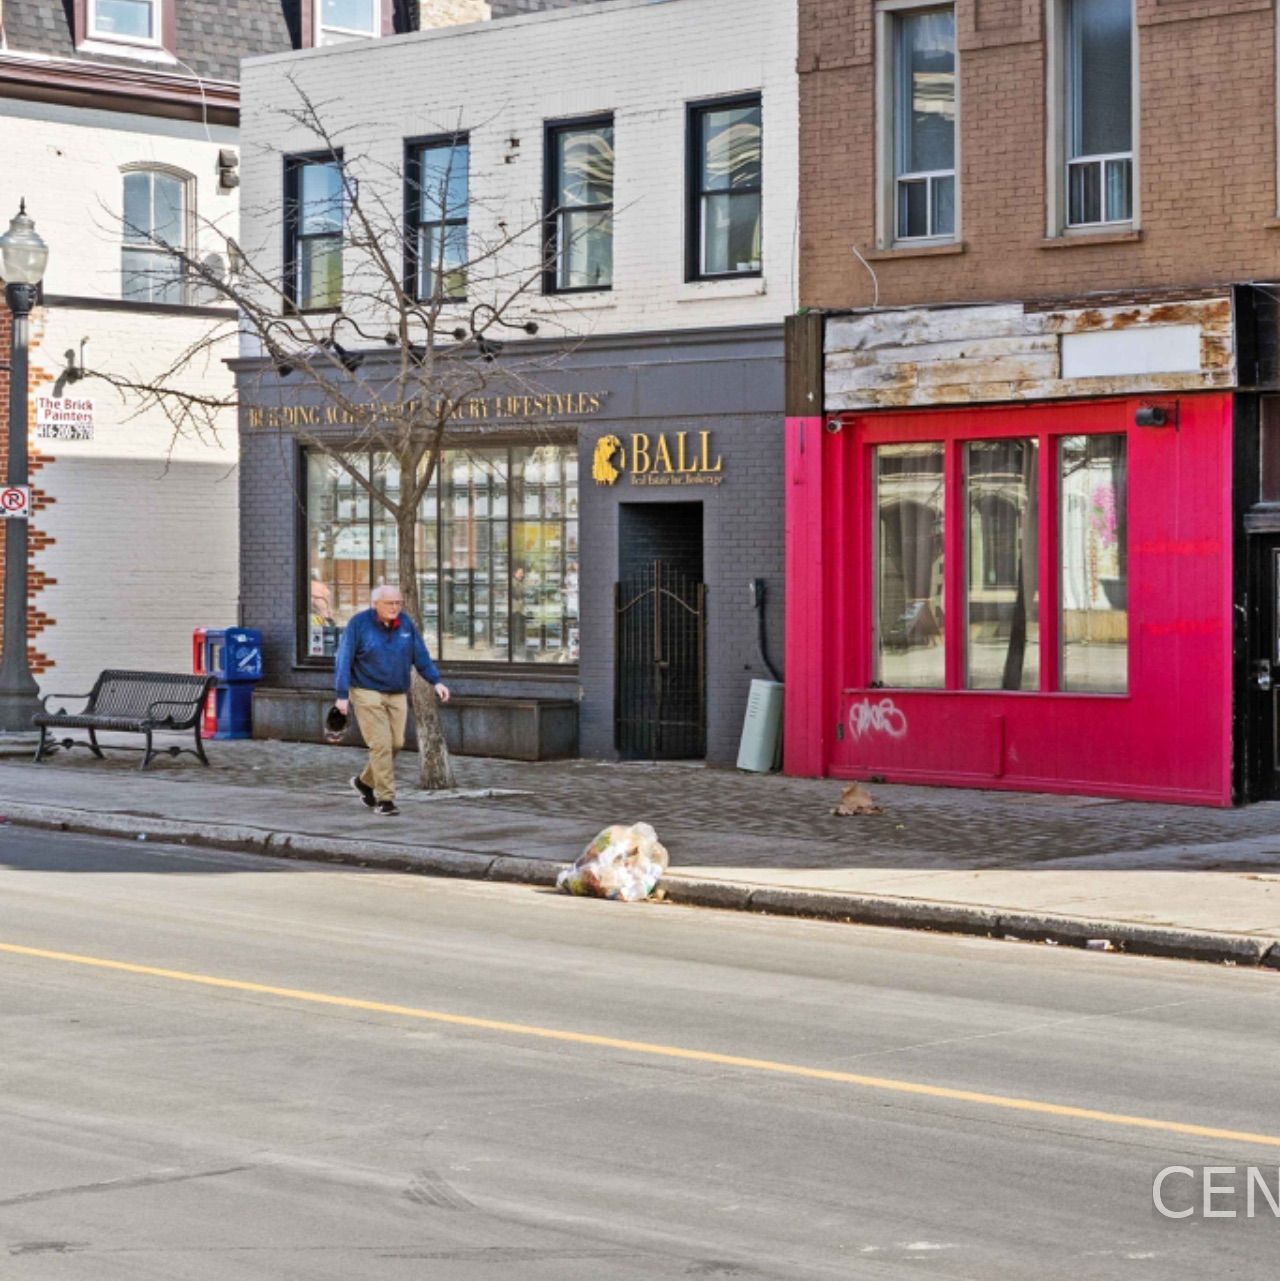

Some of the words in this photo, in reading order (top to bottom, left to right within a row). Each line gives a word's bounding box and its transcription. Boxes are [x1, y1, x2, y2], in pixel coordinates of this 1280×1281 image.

[39, 397, 61, 409] The
[64, 399, 93, 411] Brick
[436, 397, 490, 421] LXURY
[44, 409, 93, 422] Painters
[630, 430, 722, 474] BALL
